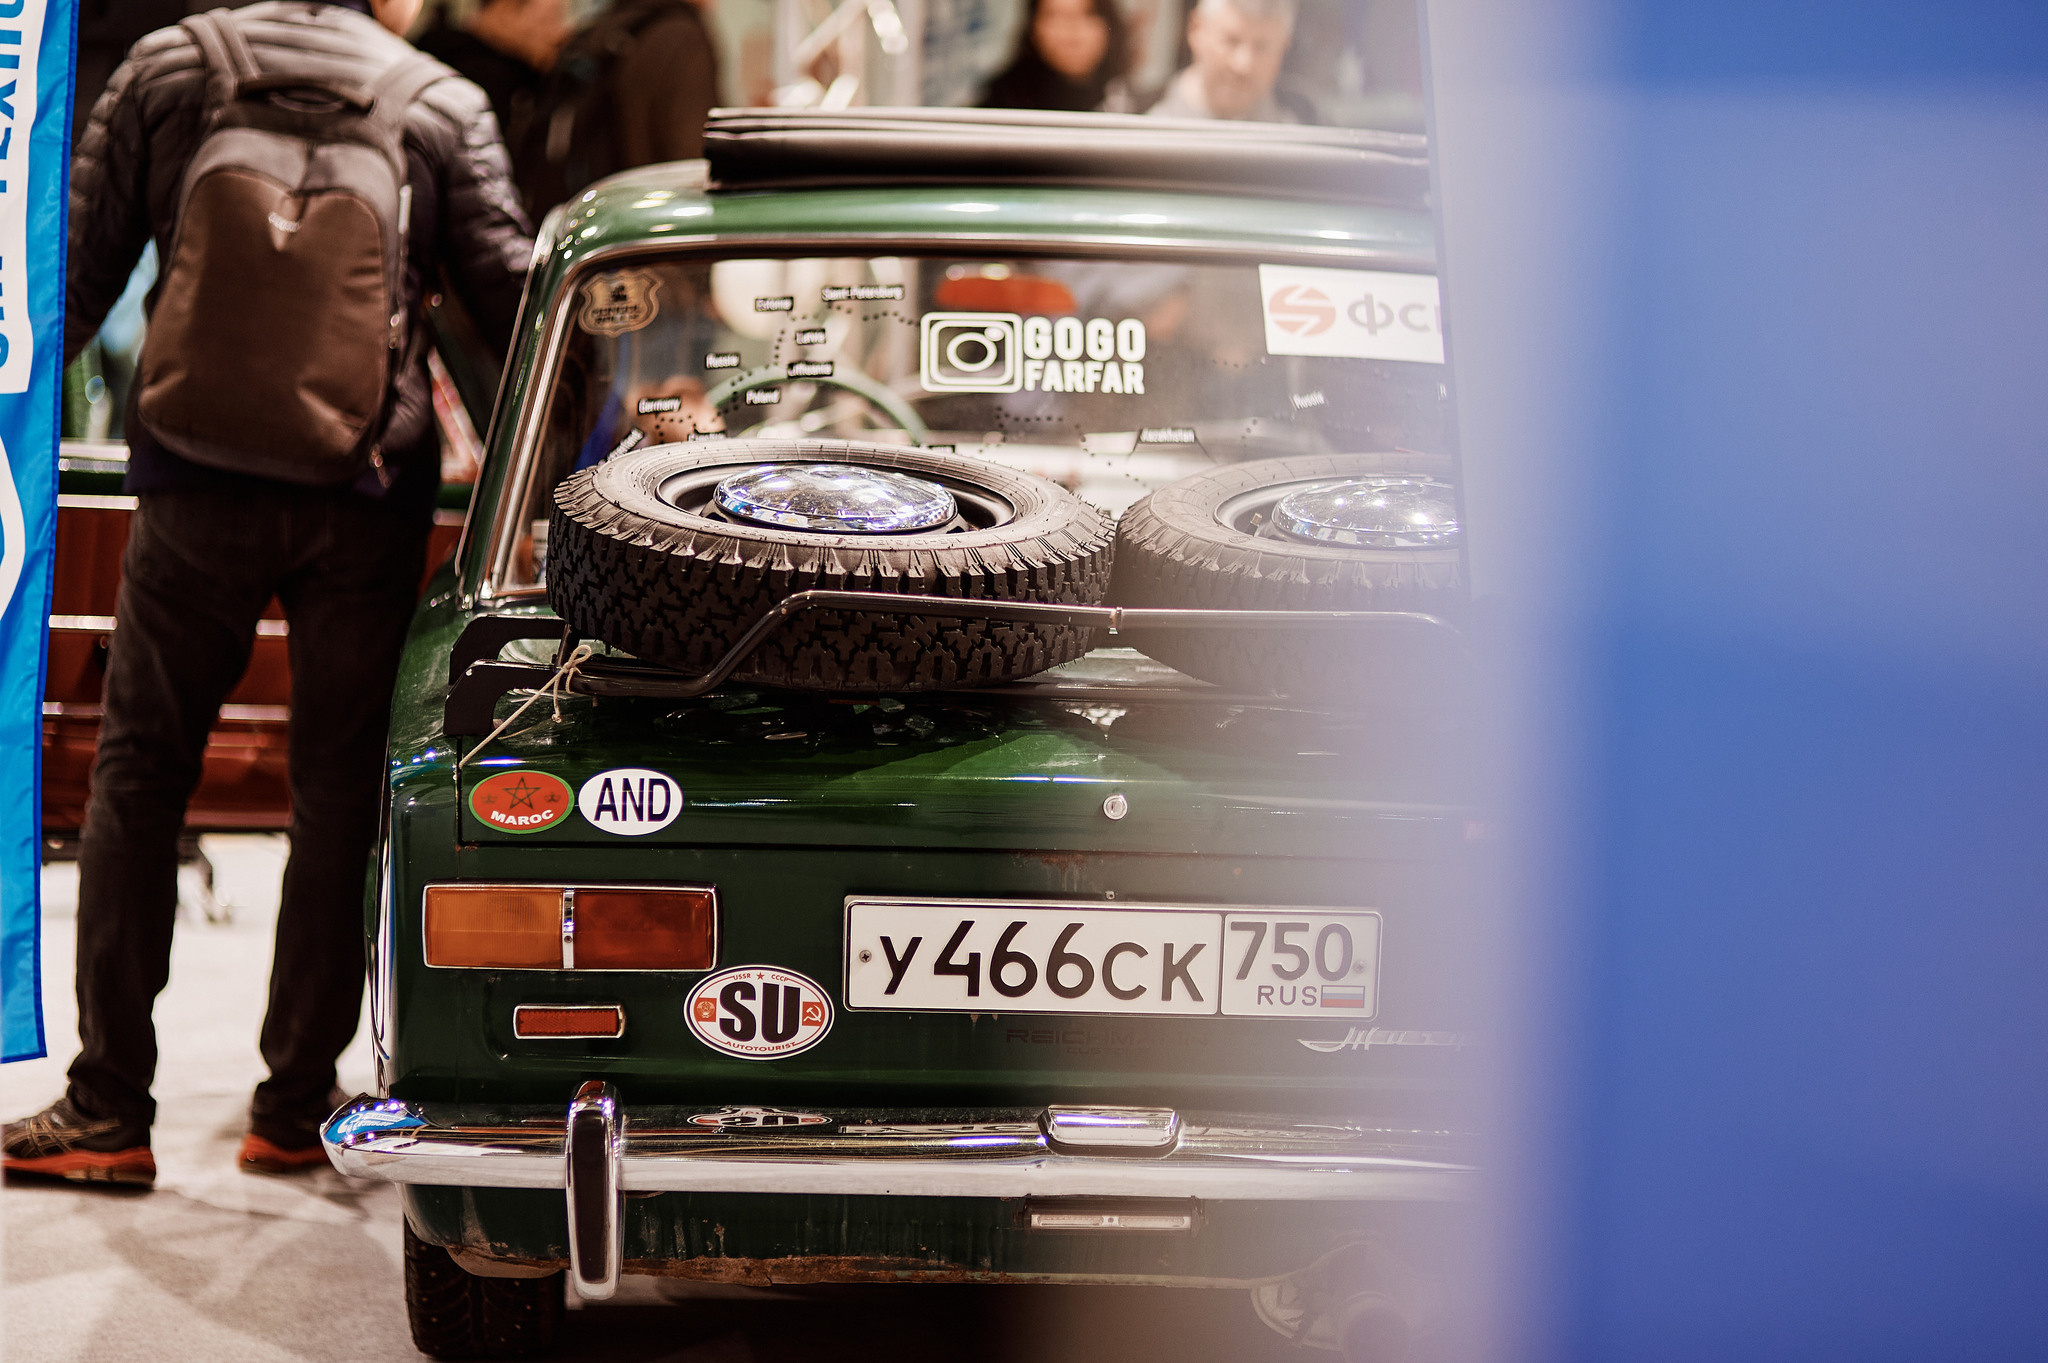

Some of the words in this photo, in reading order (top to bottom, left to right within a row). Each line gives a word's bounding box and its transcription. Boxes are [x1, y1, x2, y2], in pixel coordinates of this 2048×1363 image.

[1023, 316, 1146, 362] GOGO
[1023, 359, 1145, 394] FARFAR
[639, 398, 681, 413] Germany
[594, 778, 671, 821] AND
[490, 810, 554, 826] MAROC
[1230, 921, 1353, 982] 750
[719, 981, 800, 1043] SU
[1257, 985, 1317, 1006] RUS
[725, 1041, 797, 1052] AUTOTOURIST
